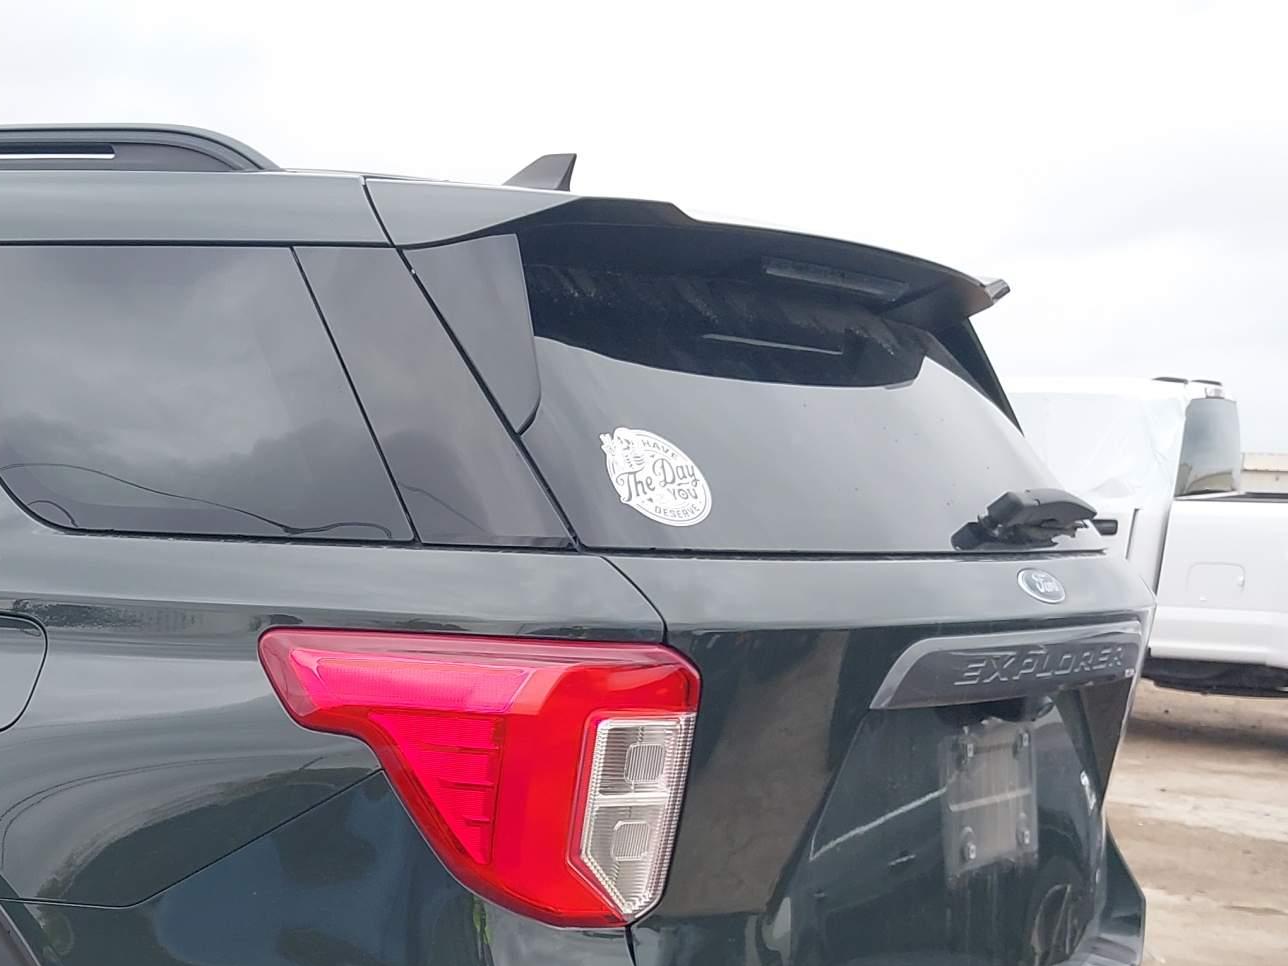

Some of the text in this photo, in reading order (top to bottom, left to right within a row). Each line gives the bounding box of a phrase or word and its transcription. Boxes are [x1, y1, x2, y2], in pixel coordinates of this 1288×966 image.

[615, 457, 700, 503] The Day
[666, 487, 699, 501] YOU
[654, 503, 701, 519] DESERVE
[953, 646, 1124, 686] EXPLORER
